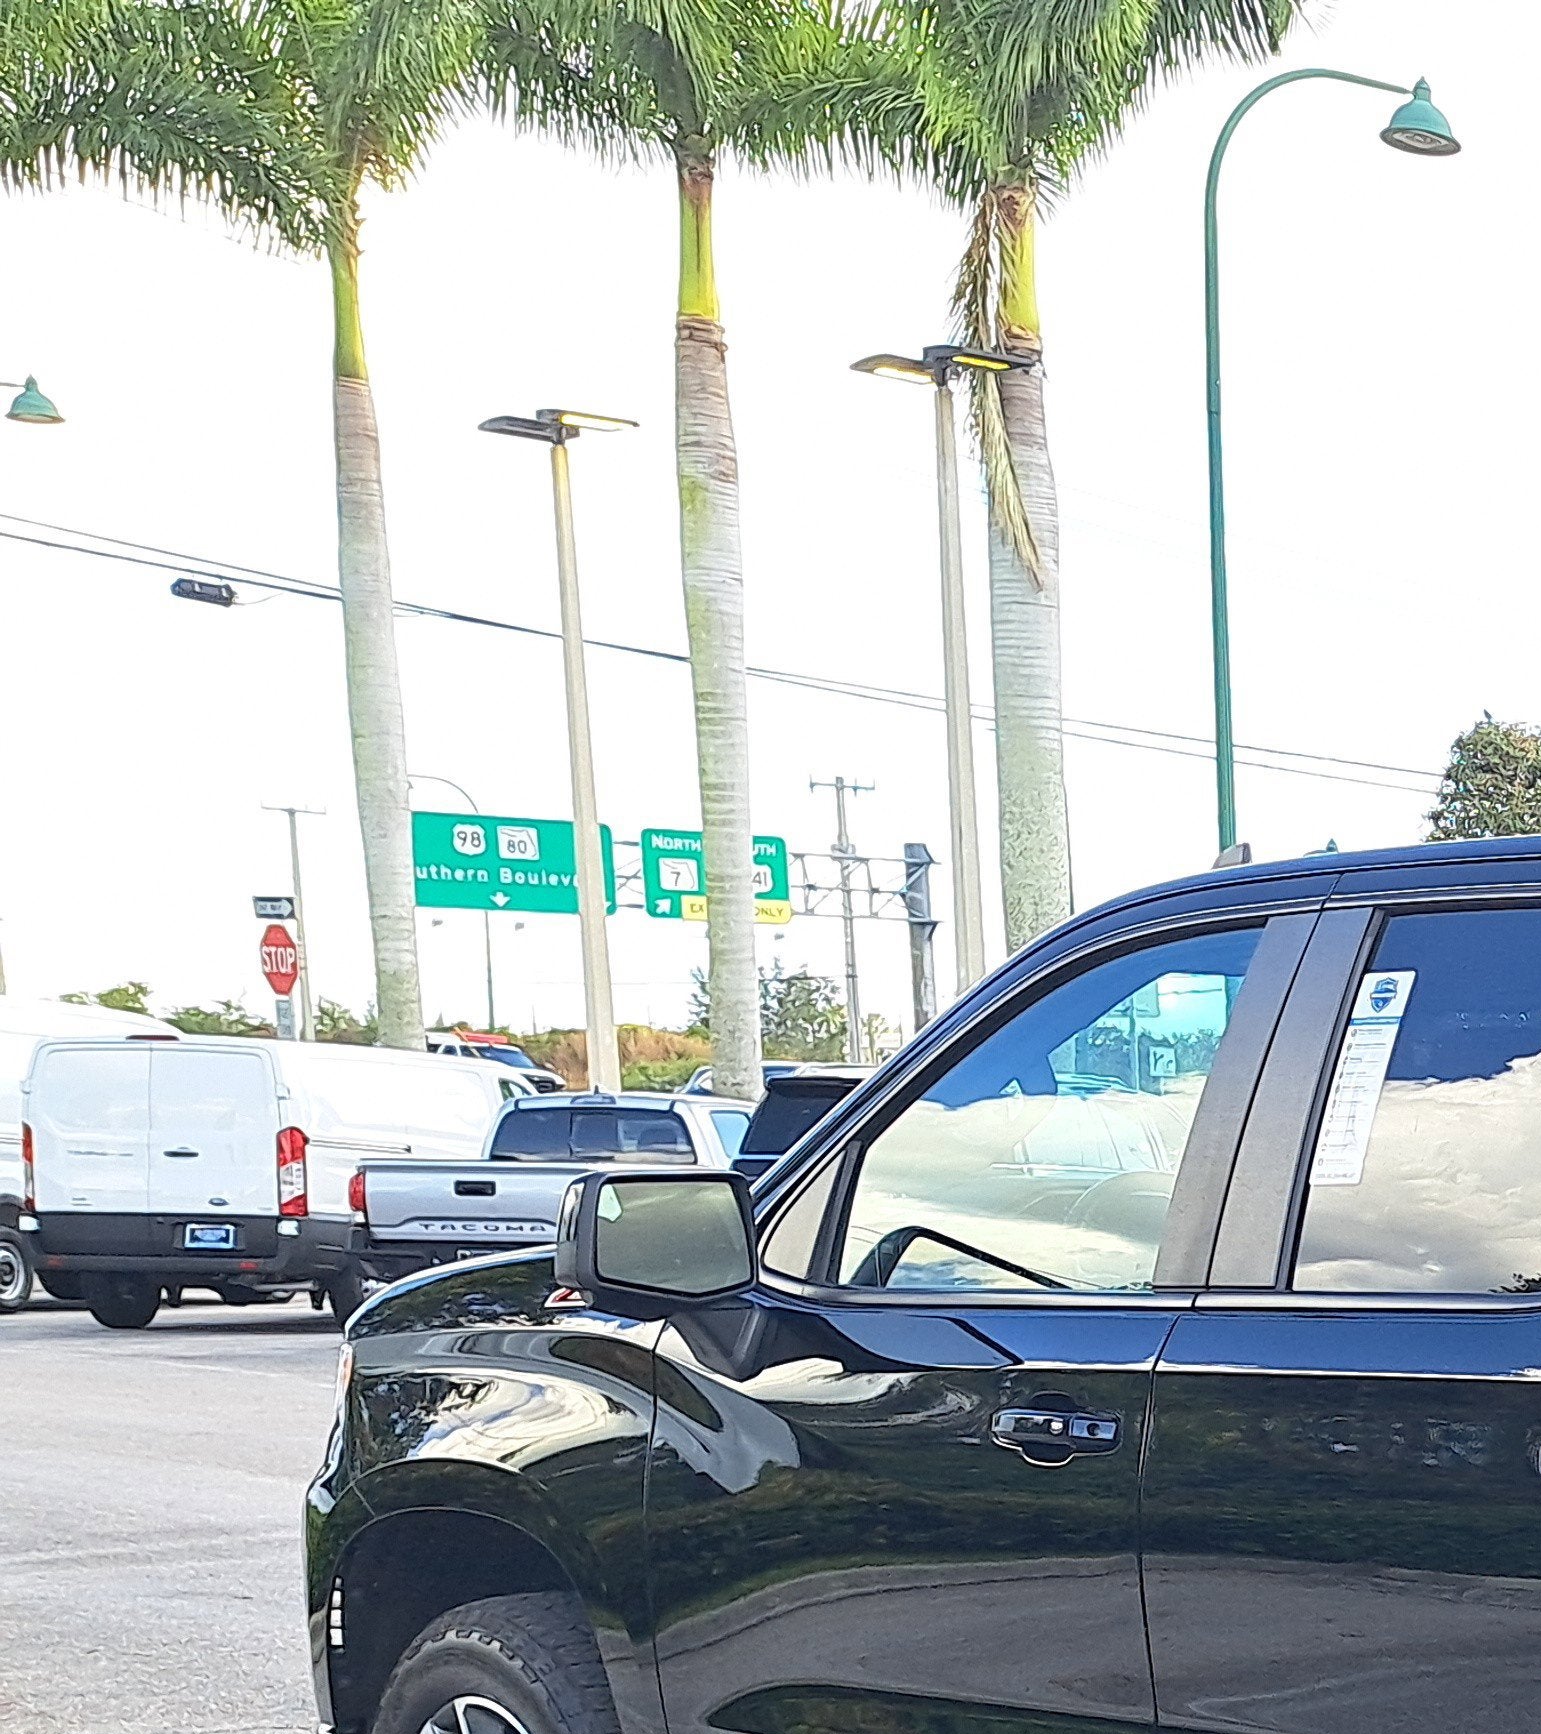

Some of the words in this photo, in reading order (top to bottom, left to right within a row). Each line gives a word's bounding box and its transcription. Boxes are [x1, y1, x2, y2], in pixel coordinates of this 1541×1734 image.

[455, 830, 482, 849] 98
[506, 839, 528, 855] 80
[651, 834, 702, 853] NORTH
[670, 871, 681, 887] 7
[261, 946, 296, 974] STOP
[419, 1222, 547, 1233] TACOMA
